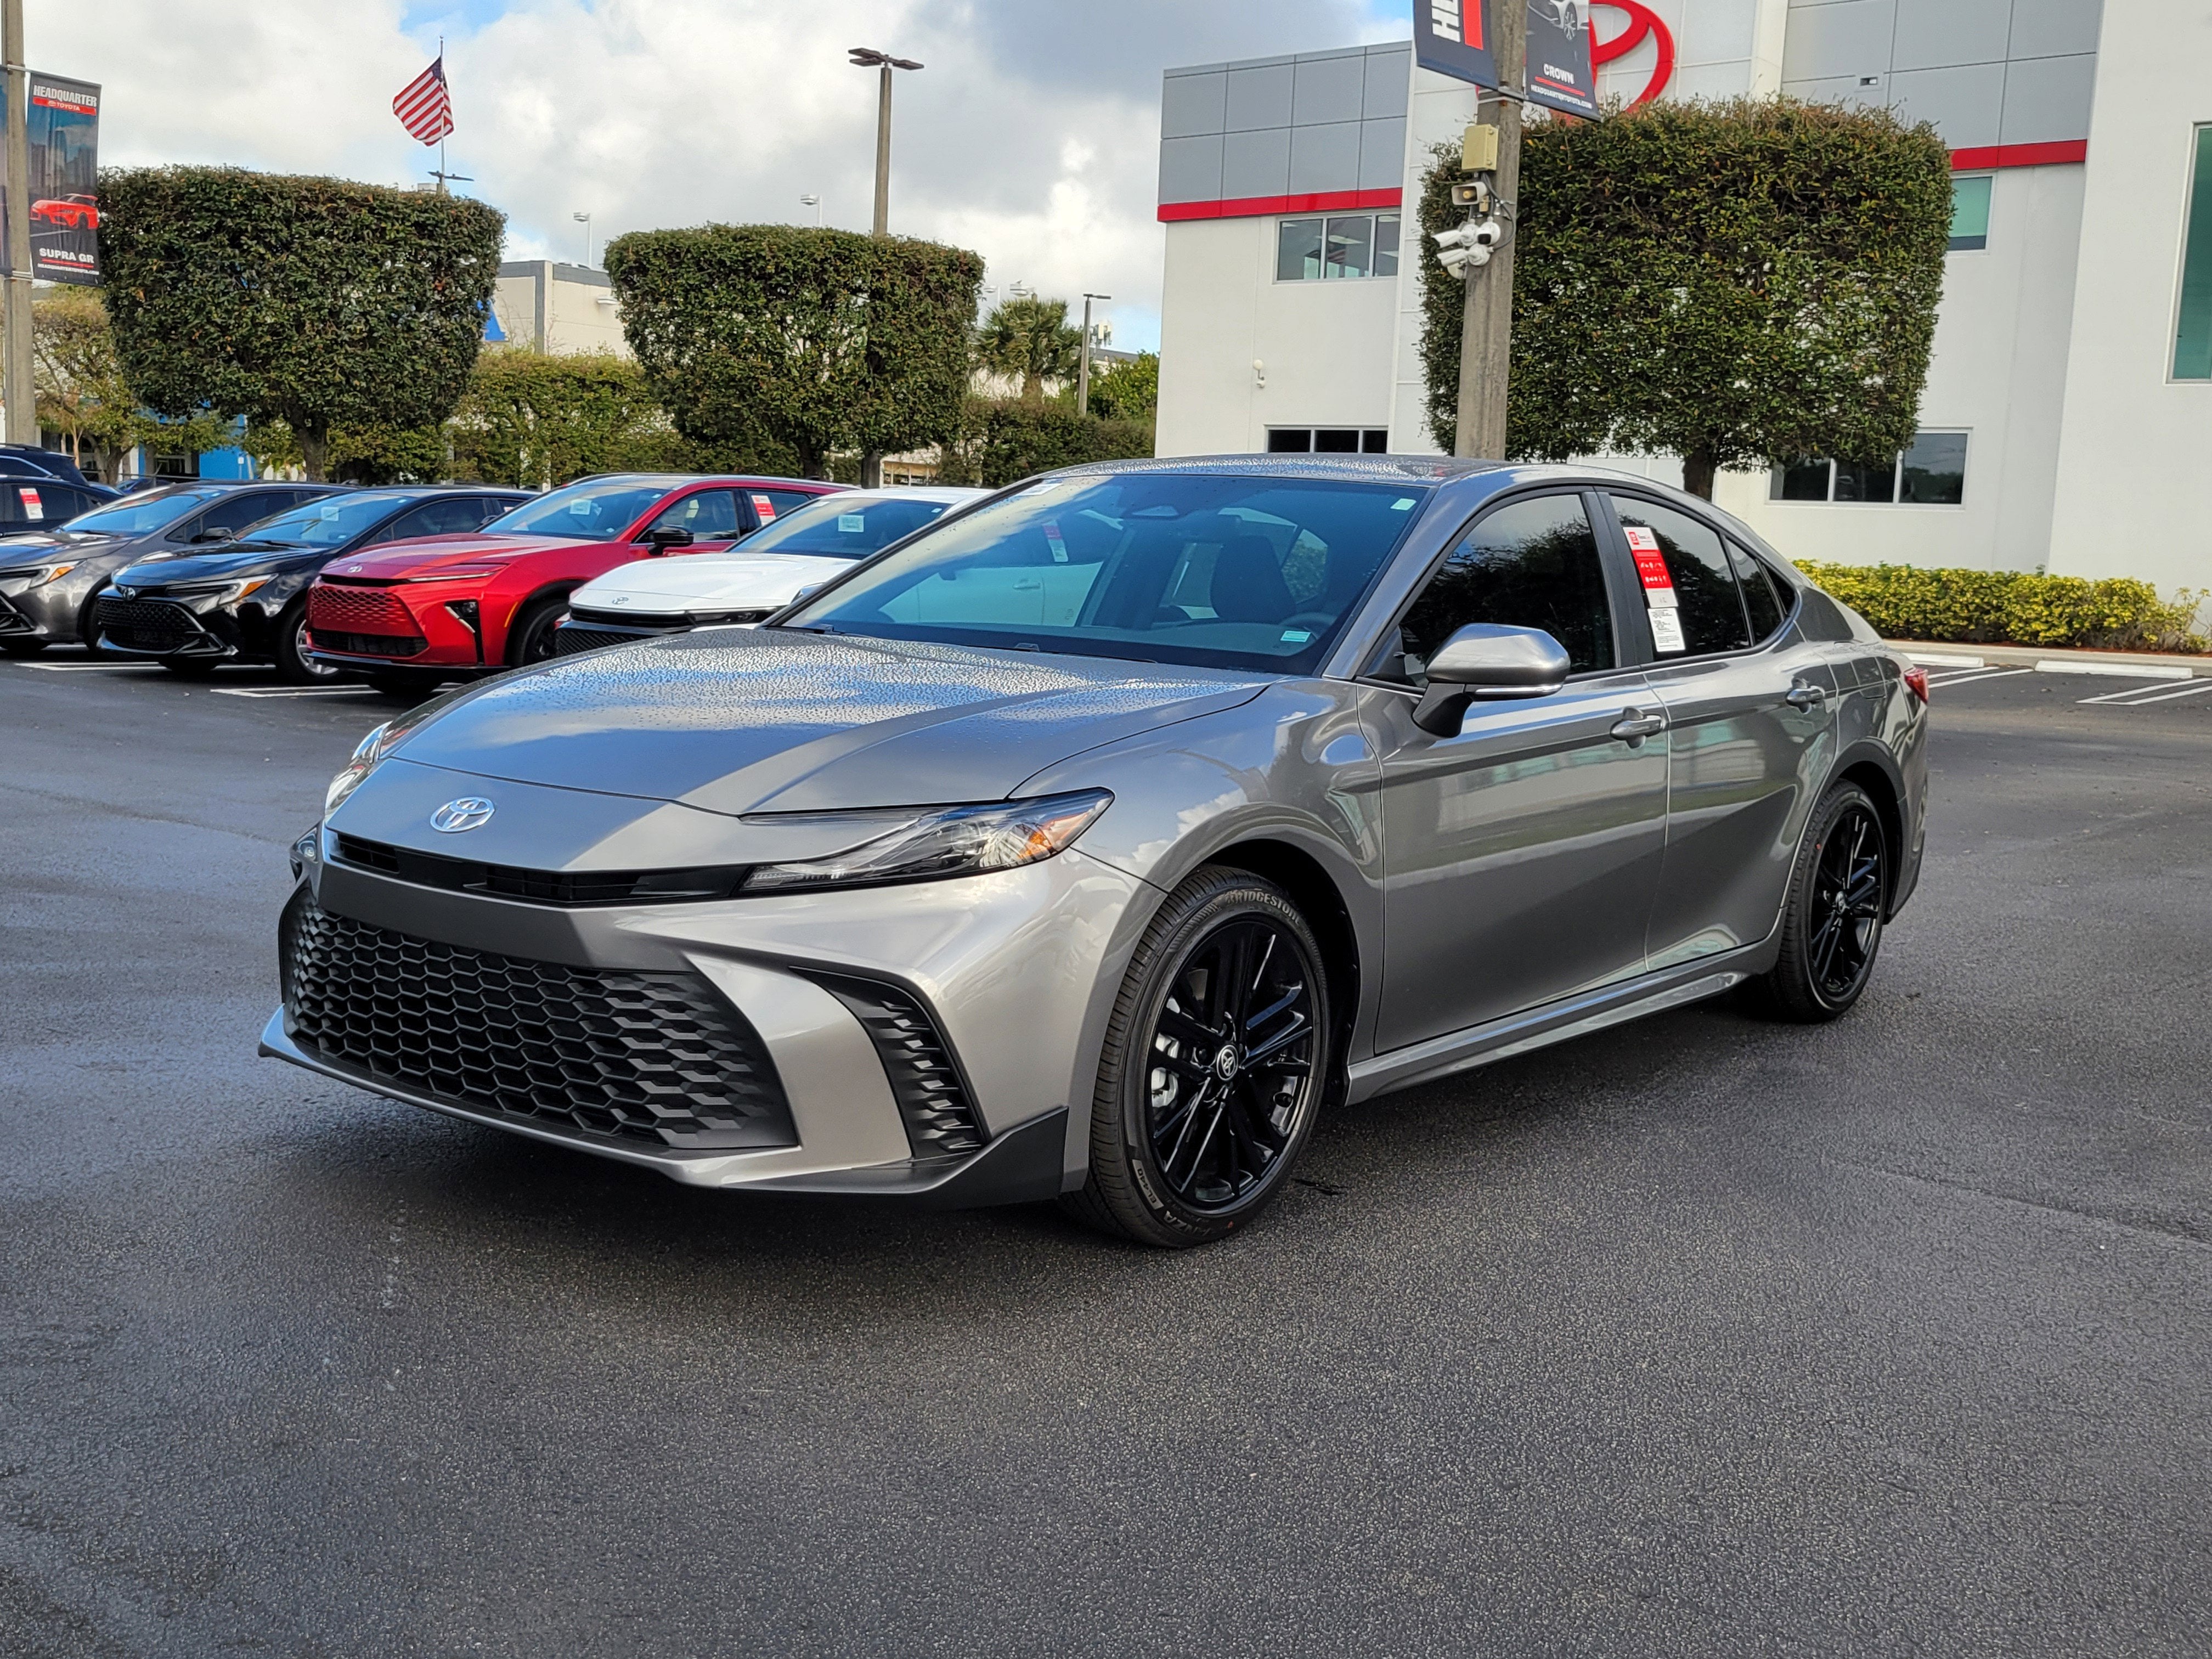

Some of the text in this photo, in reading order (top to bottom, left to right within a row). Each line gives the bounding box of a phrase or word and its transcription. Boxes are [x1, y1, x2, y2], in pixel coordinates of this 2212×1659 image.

[1544, 63, 1575, 84] CROWN
[33, 84, 97, 107] HEADQUARTER
[57, 102, 81, 111] TOYOTA
[39, 248, 94, 263] SUPRA GR
[1137, 1168, 1157, 1204] EL440
